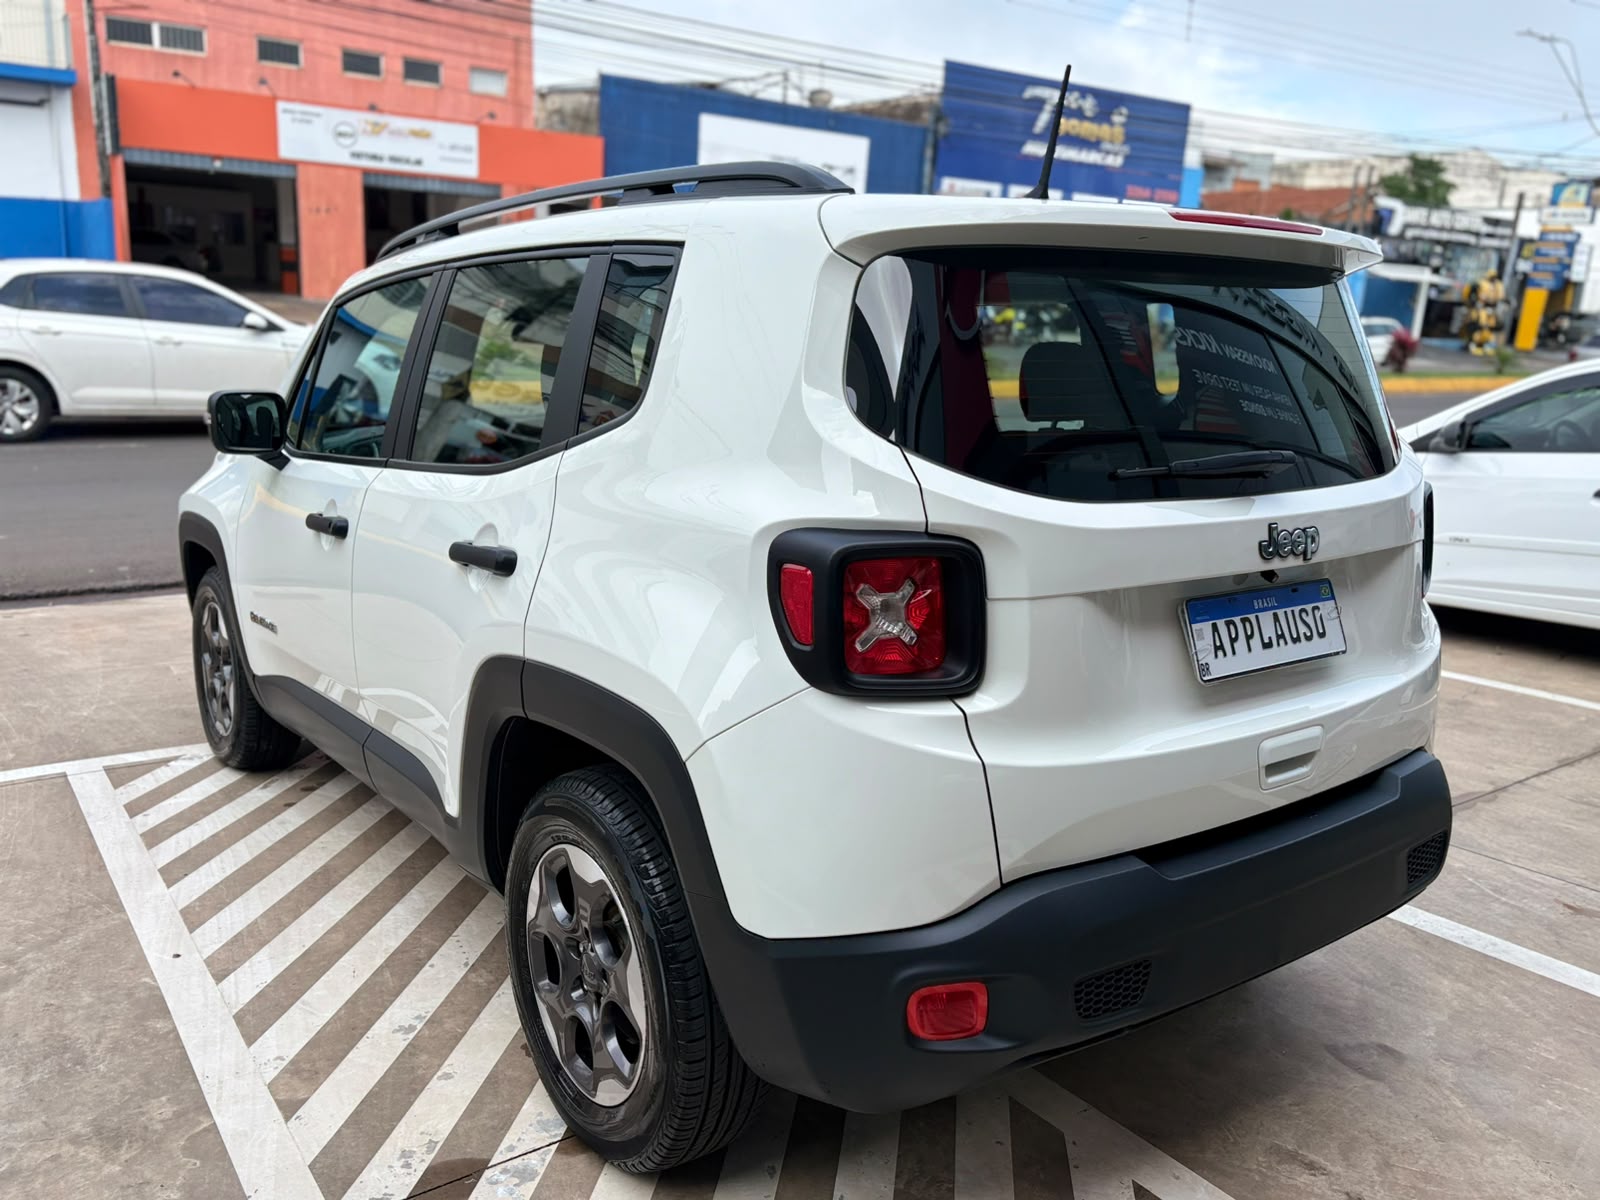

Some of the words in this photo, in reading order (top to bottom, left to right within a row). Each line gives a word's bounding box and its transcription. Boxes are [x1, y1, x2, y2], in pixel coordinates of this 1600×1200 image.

[1258, 522, 1320, 561] Jeep
[1253, 596, 1278, 610] BRASIL
[1210, 605, 1327, 659] APPLAUSO
[1200, 662, 1212, 678] BR
